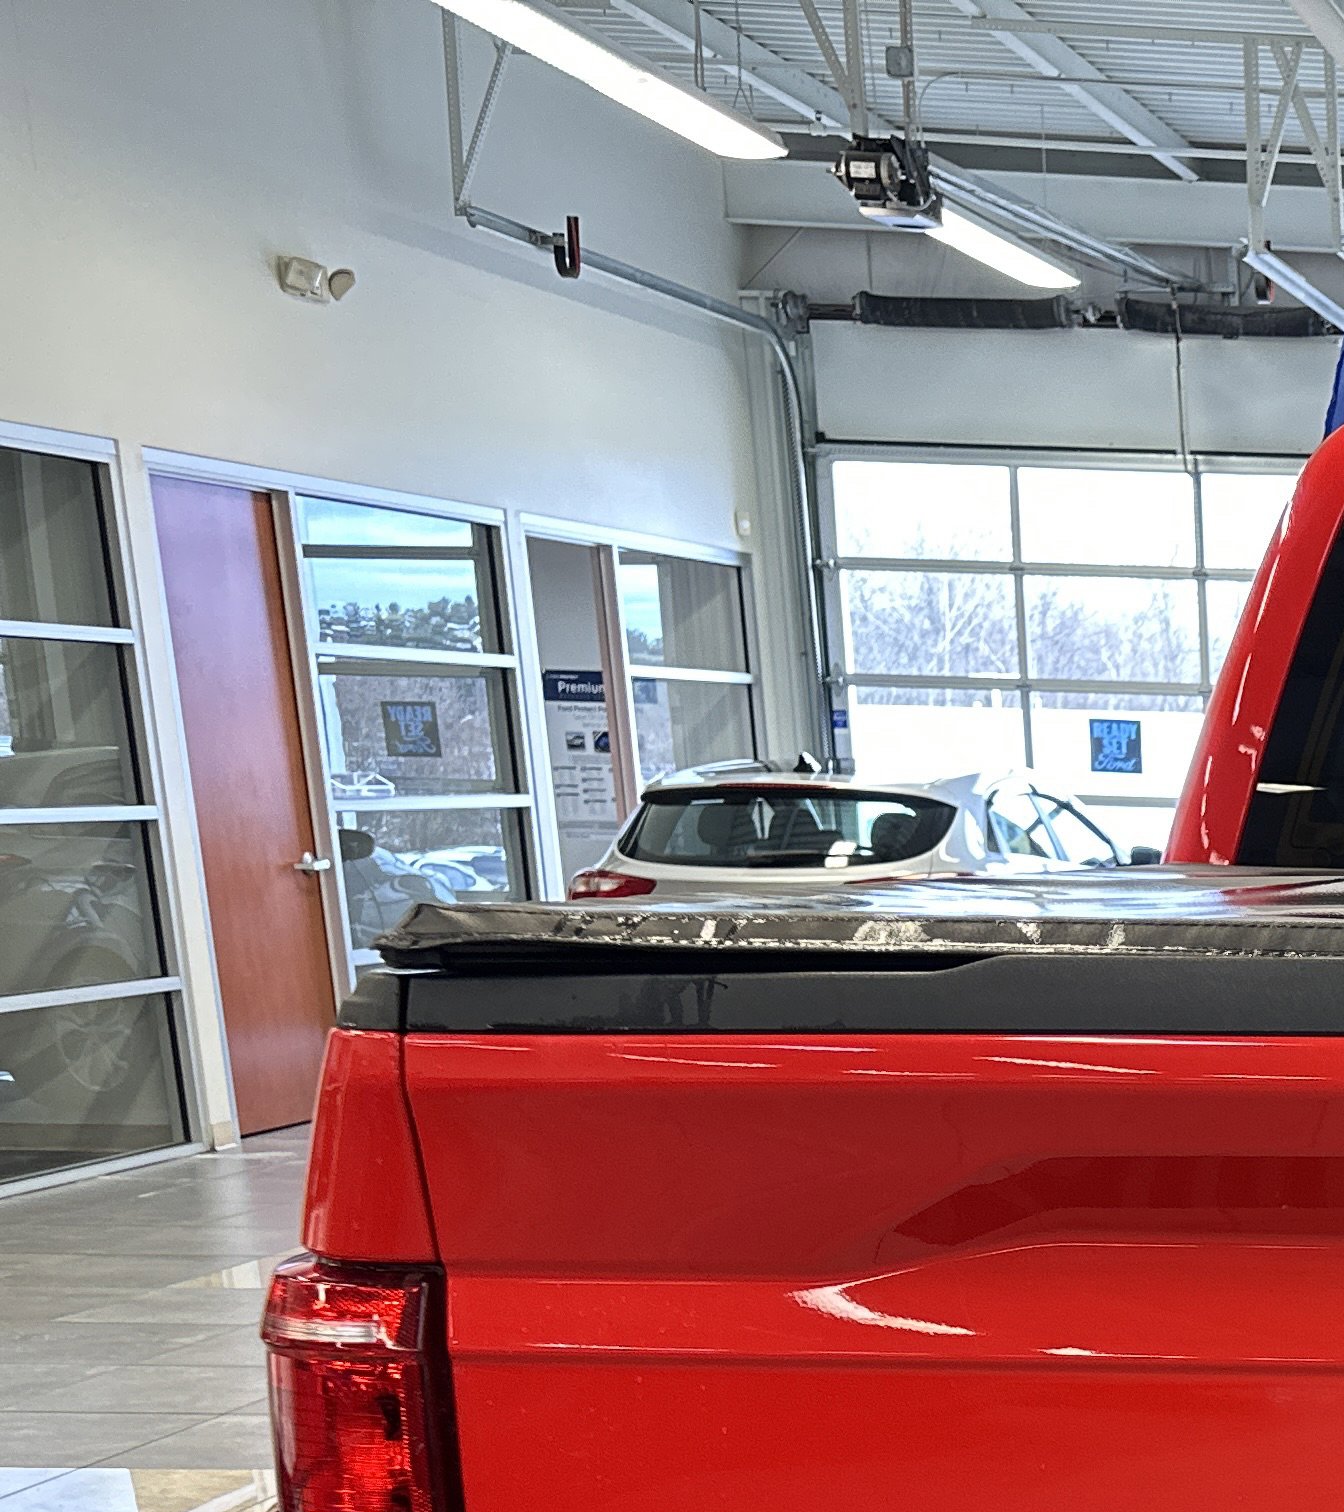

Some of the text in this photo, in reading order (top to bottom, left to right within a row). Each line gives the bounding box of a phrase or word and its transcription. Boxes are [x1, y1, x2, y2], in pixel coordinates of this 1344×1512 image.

[1093, 722, 1138, 739] READY
[1102, 737, 1127, 754] SET
[1095, 752, 1136, 770] Ford
